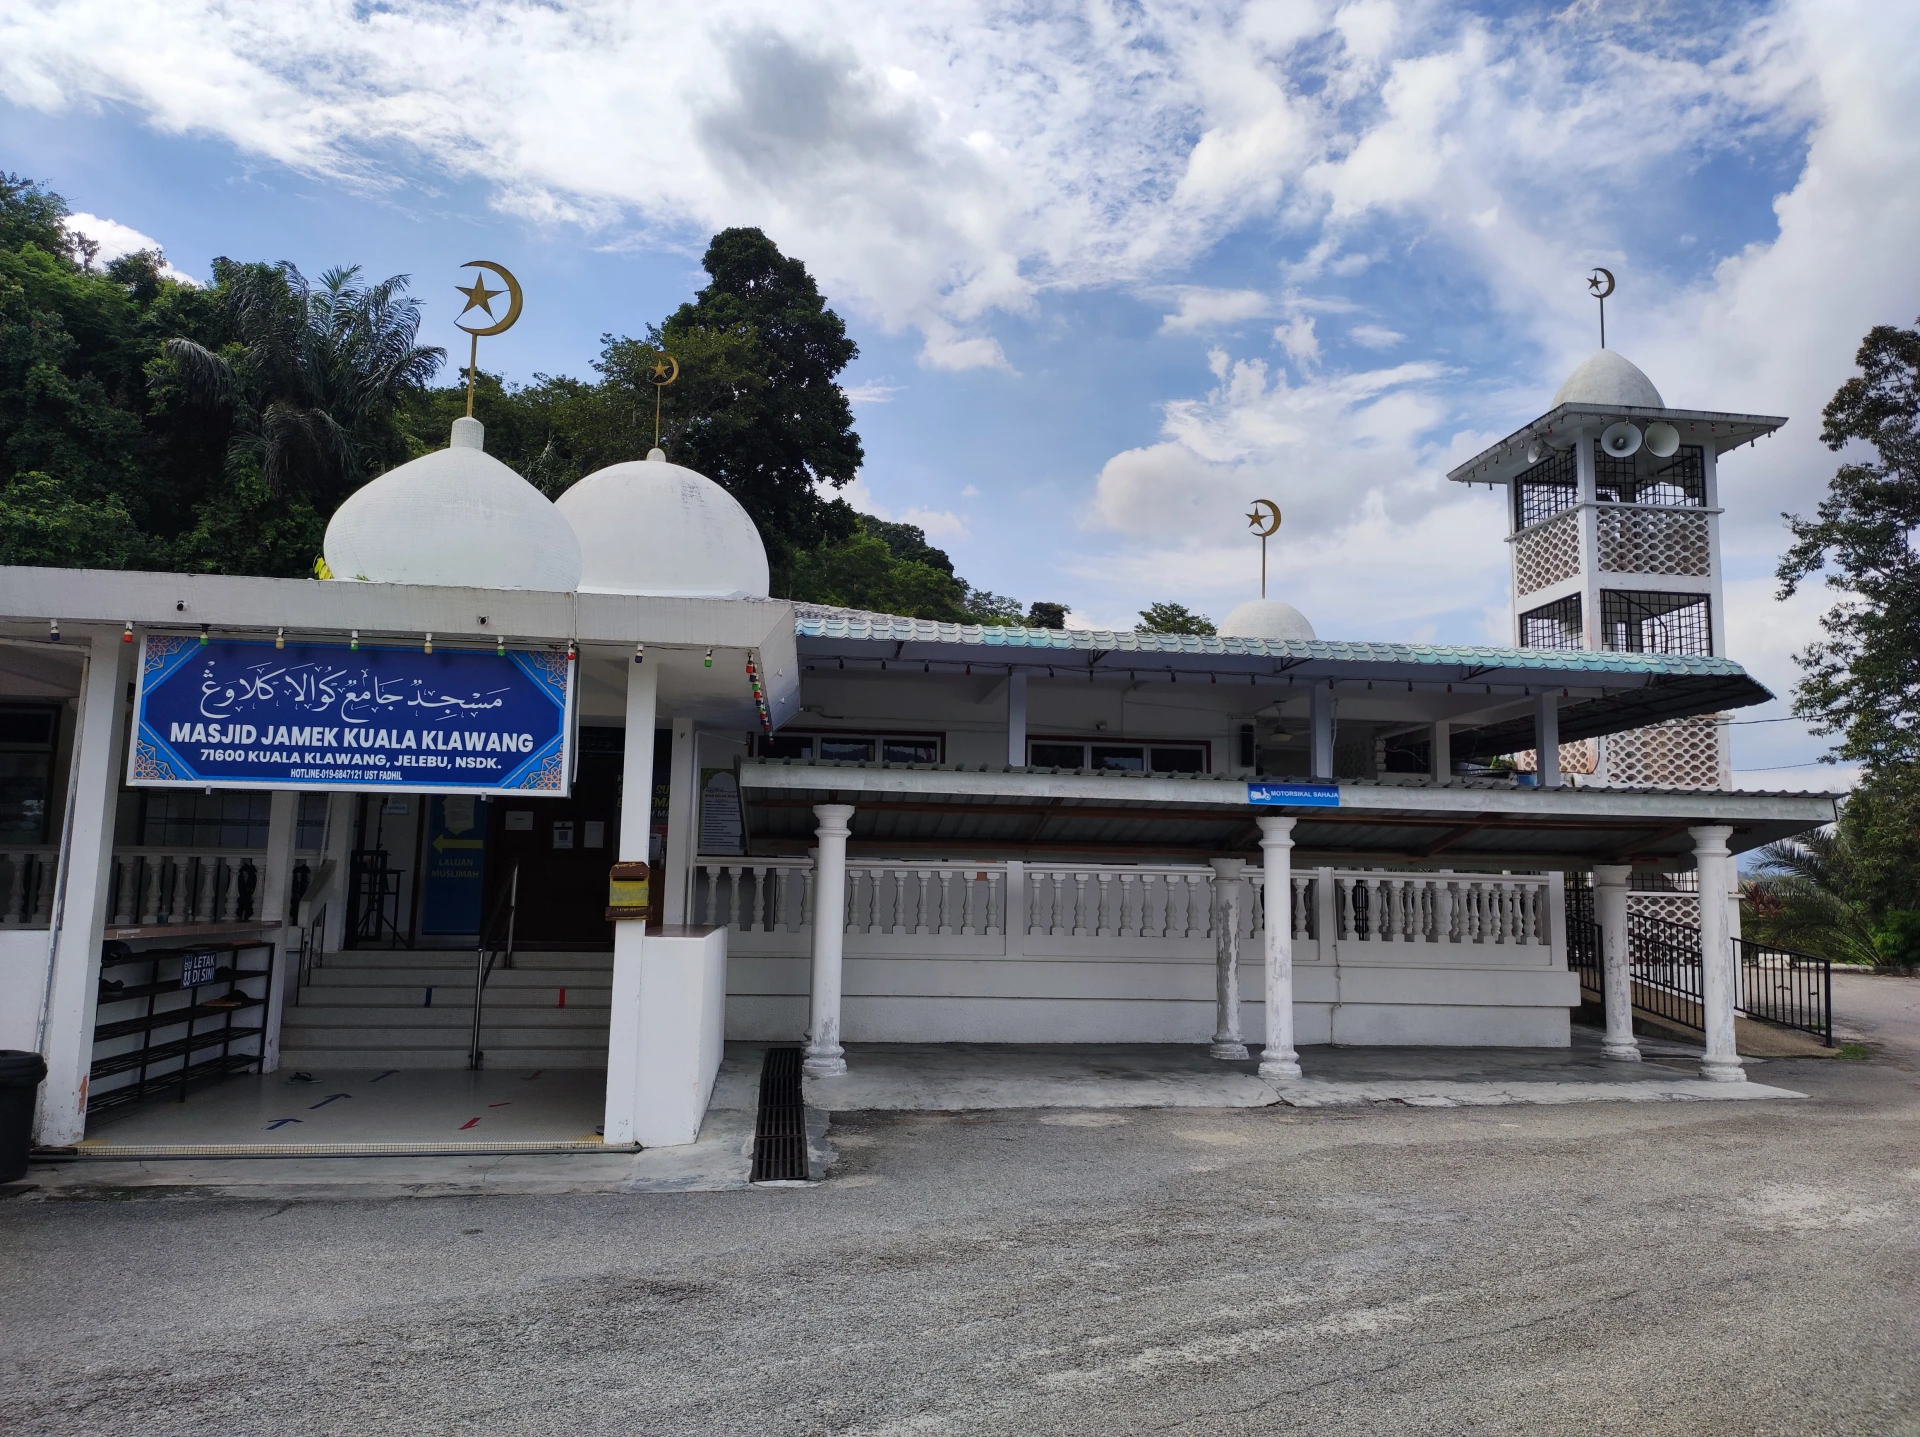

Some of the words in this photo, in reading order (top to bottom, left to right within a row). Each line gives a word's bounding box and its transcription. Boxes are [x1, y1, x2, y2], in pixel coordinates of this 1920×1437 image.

[170, 722, 257, 745] MASJID
[261, 725, 340, 748] JAMEK
[343, 728, 417, 750] KUALA
[421, 730, 534, 753] KLAWANG
[200, 749, 245, 762] 71600
[248, 751, 301, 764] KUALA
[304, 752, 390, 768] KLAWANG,
[394, 755, 452, 770] JELEBU,
[455, 756, 502, 769] NSDK.
[290, 768, 362, 779] HOTLINE-019-6847121
[364, 770, 378, 780] UST
[379, 770, 403, 780] FADHIL
[1271, 790, 1312, 798] MOTORSIKAL
[438, 857, 473, 867] LALUAN
[431, 869, 479, 878] MUSLIMAH
[193, 955, 215, 968] LETAK
[192, 969, 200, 983] DI
[201, 967, 215, 982] SINI
